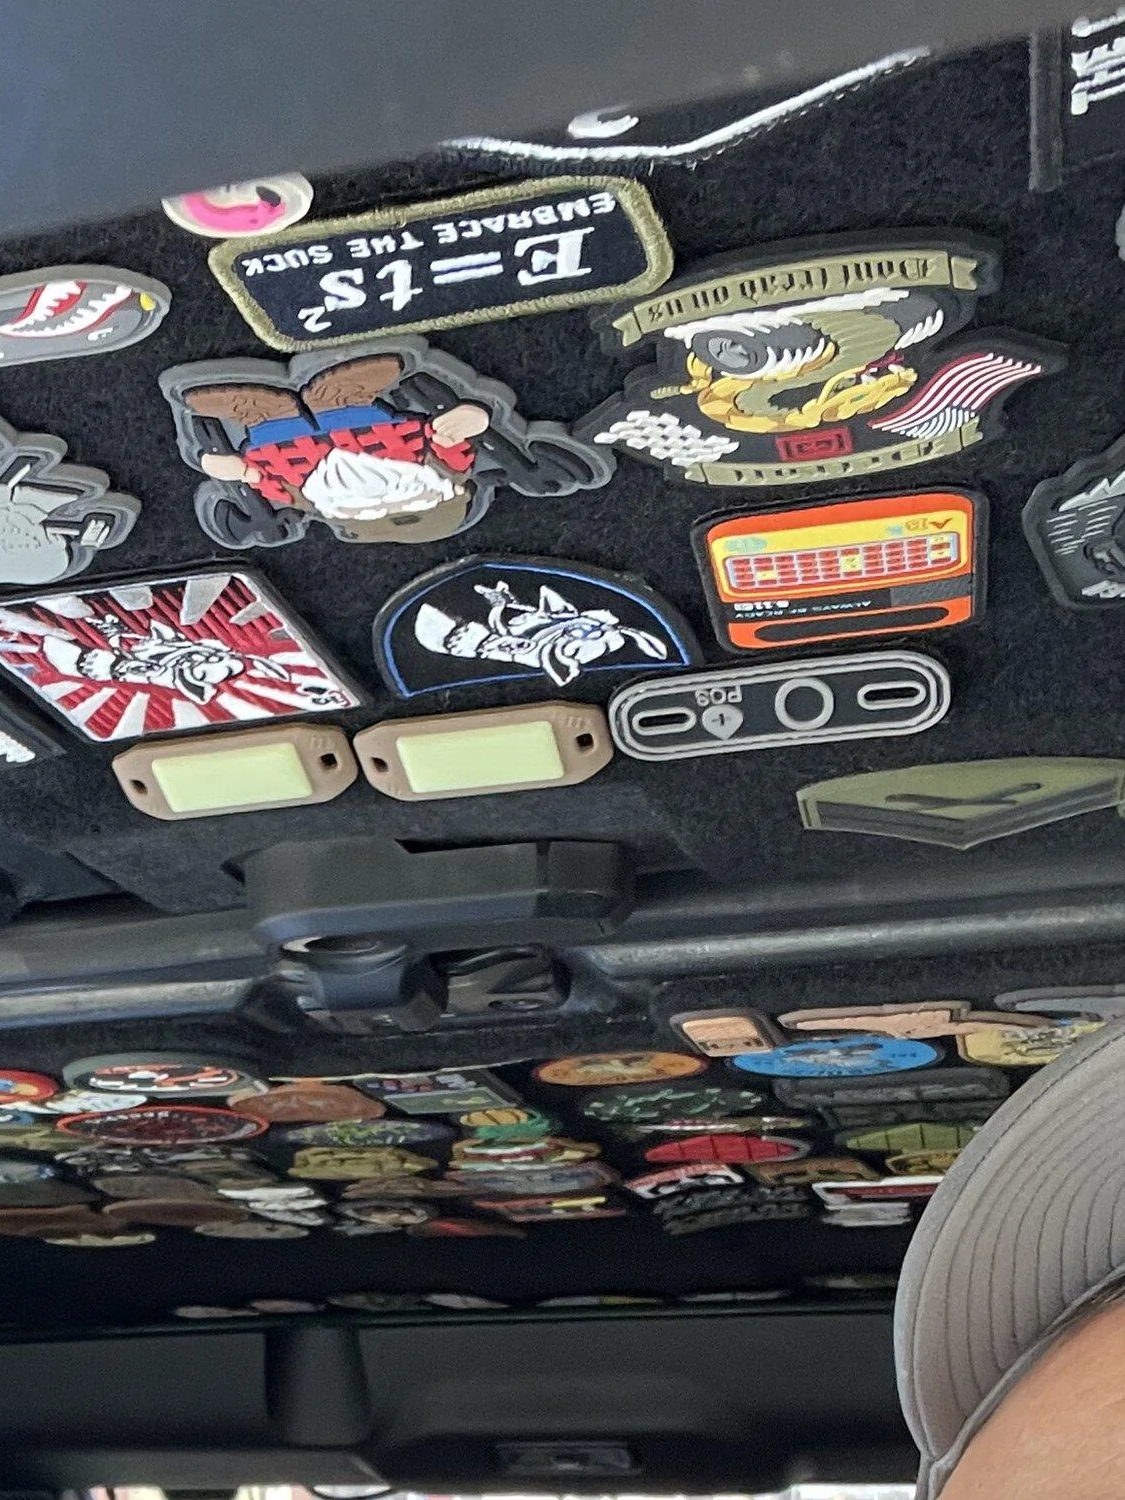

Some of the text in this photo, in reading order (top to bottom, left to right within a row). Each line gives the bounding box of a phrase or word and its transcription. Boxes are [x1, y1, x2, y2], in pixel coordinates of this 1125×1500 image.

[242, 192, 617, 277] EMBRACE THE SUCK
[692, 285, 729, 310] on
[739, 267, 827, 304] tread
[648, 298, 682, 322] us
[695, 685, 743, 707] POS
